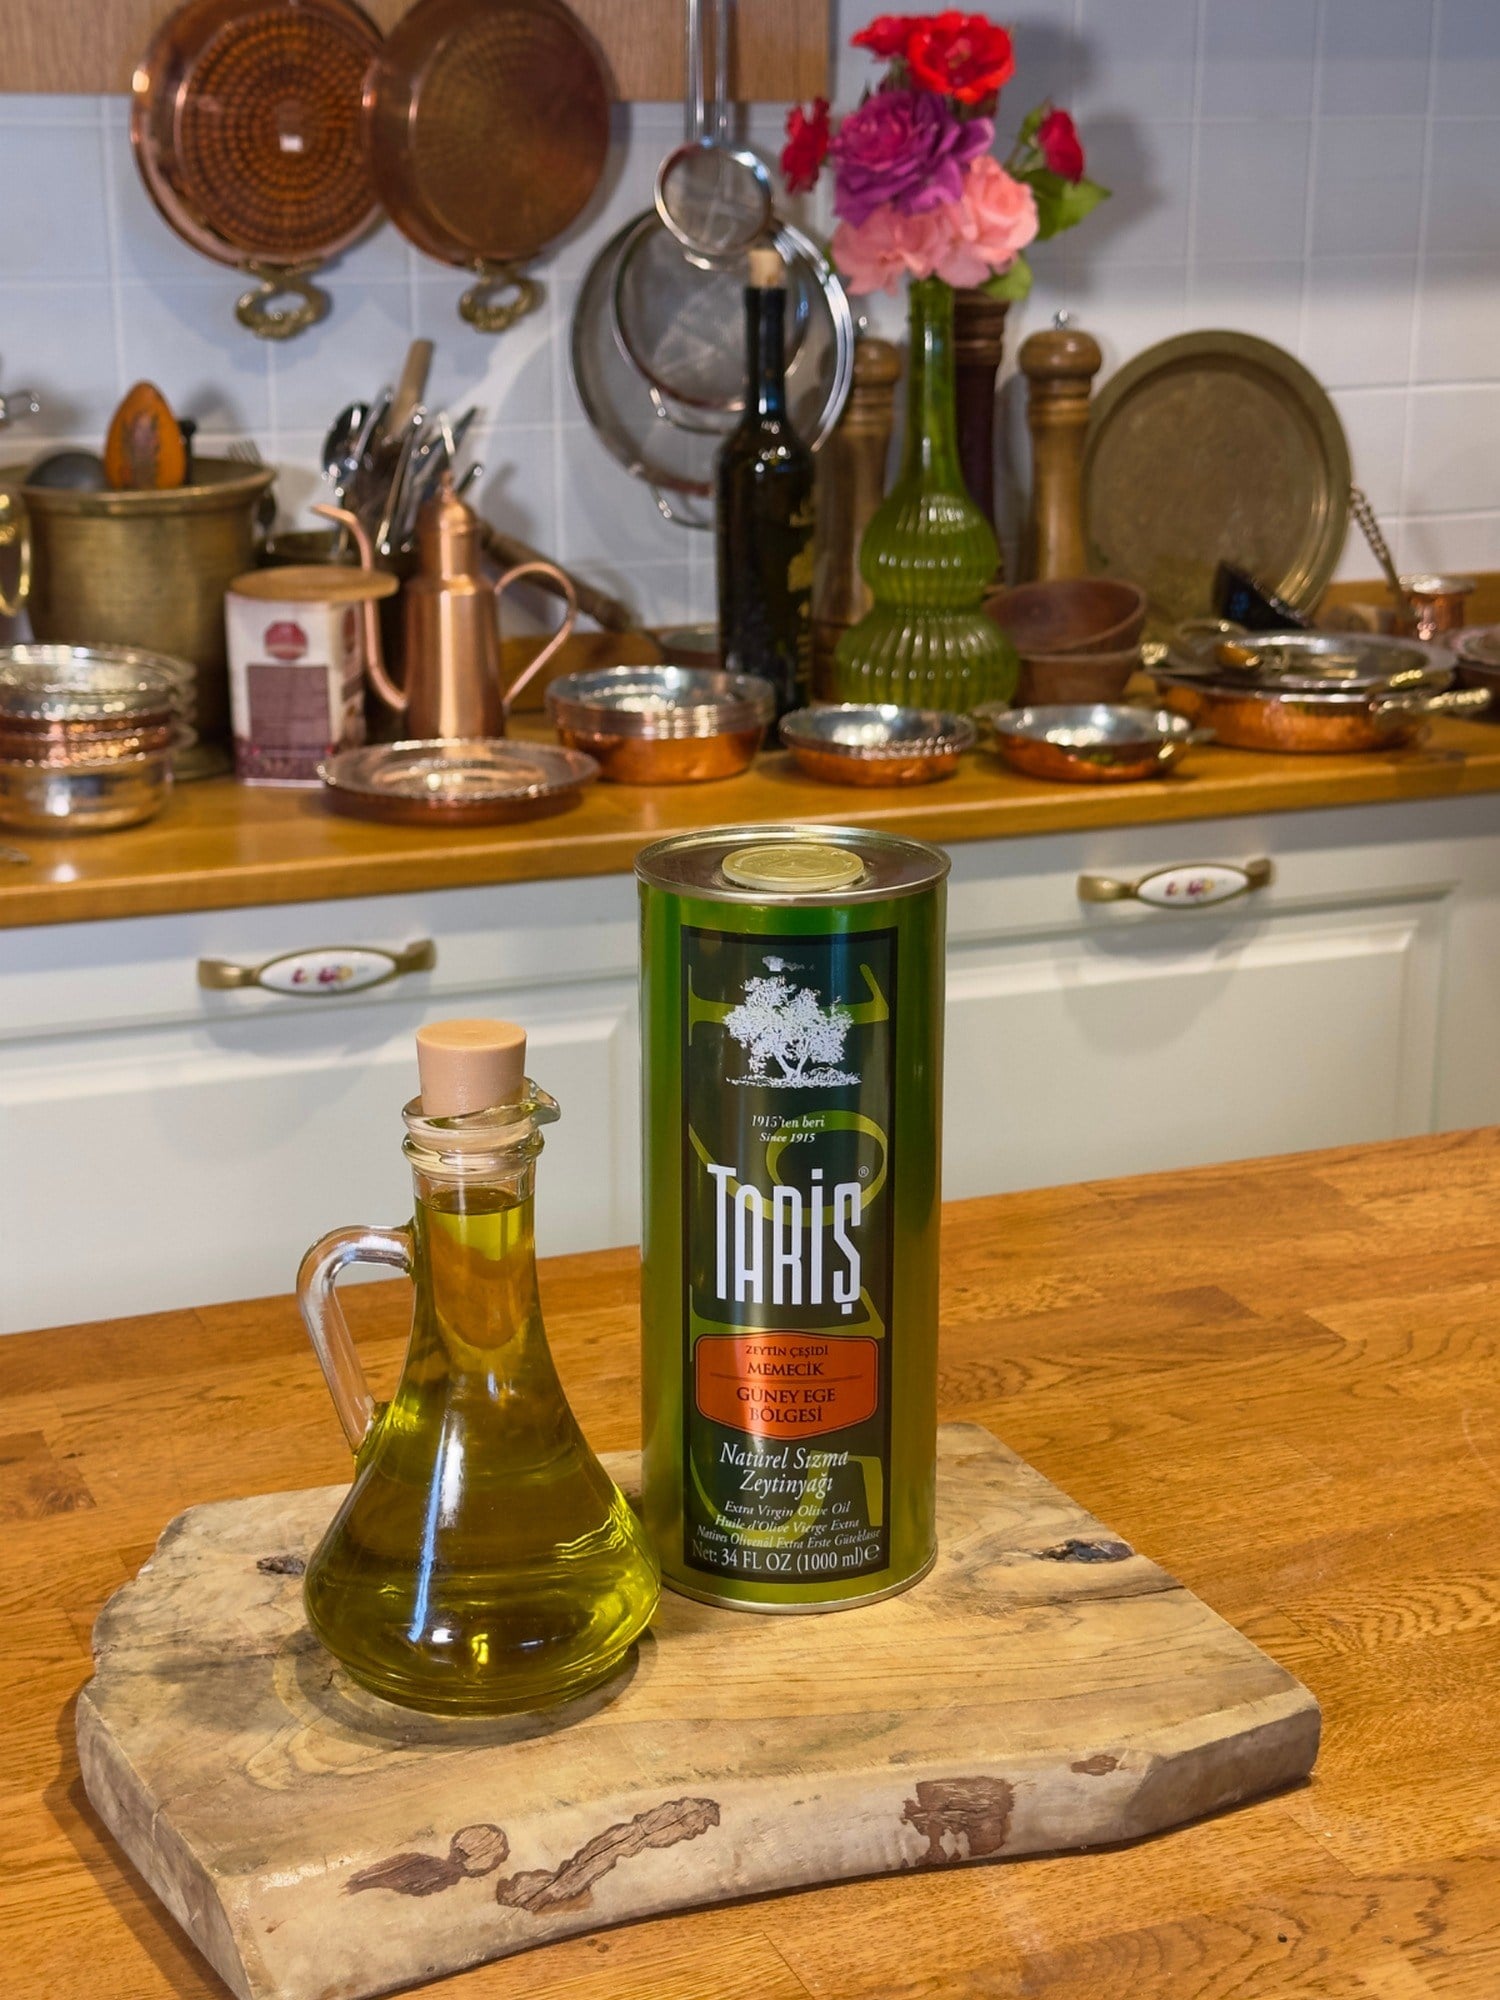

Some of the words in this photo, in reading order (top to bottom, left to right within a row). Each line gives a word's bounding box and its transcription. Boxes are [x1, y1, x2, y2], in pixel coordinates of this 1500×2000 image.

[802, 1115, 825, 1128] beri
[759, 1132, 787, 1143] Since
[790, 1132, 816, 1143] 1915
[747, 1361, 824, 1376] MEMECİK
[736, 1387, 799, 1404] GÜNEY
[804, 1388, 836, 1403] EGE
[750, 1407, 822, 1423] BÖLGESİ
[793, 1448, 849, 1469] Sızma
[740, 1469, 833, 1500] Zeytinyağı
[724, 1500, 754, 1515] Extra
[757, 1504, 794, 1520] Virgin
[797, 1505, 828, 1517] Olive
[831, 1501, 851, 1514] Oil
[715, 1514, 745, 1530] Huile
[793, 1521, 828, 1535] Vierge
[831, 1518, 860, 1530] Extra
[807, 1536, 831, 1549] Erste
[721, 1548, 738, 1567] 34
[742, 1551, 762, 1570] FL
[765, 1553, 791, 1571] OZ
[796, 1552, 838, 1574] (1000
